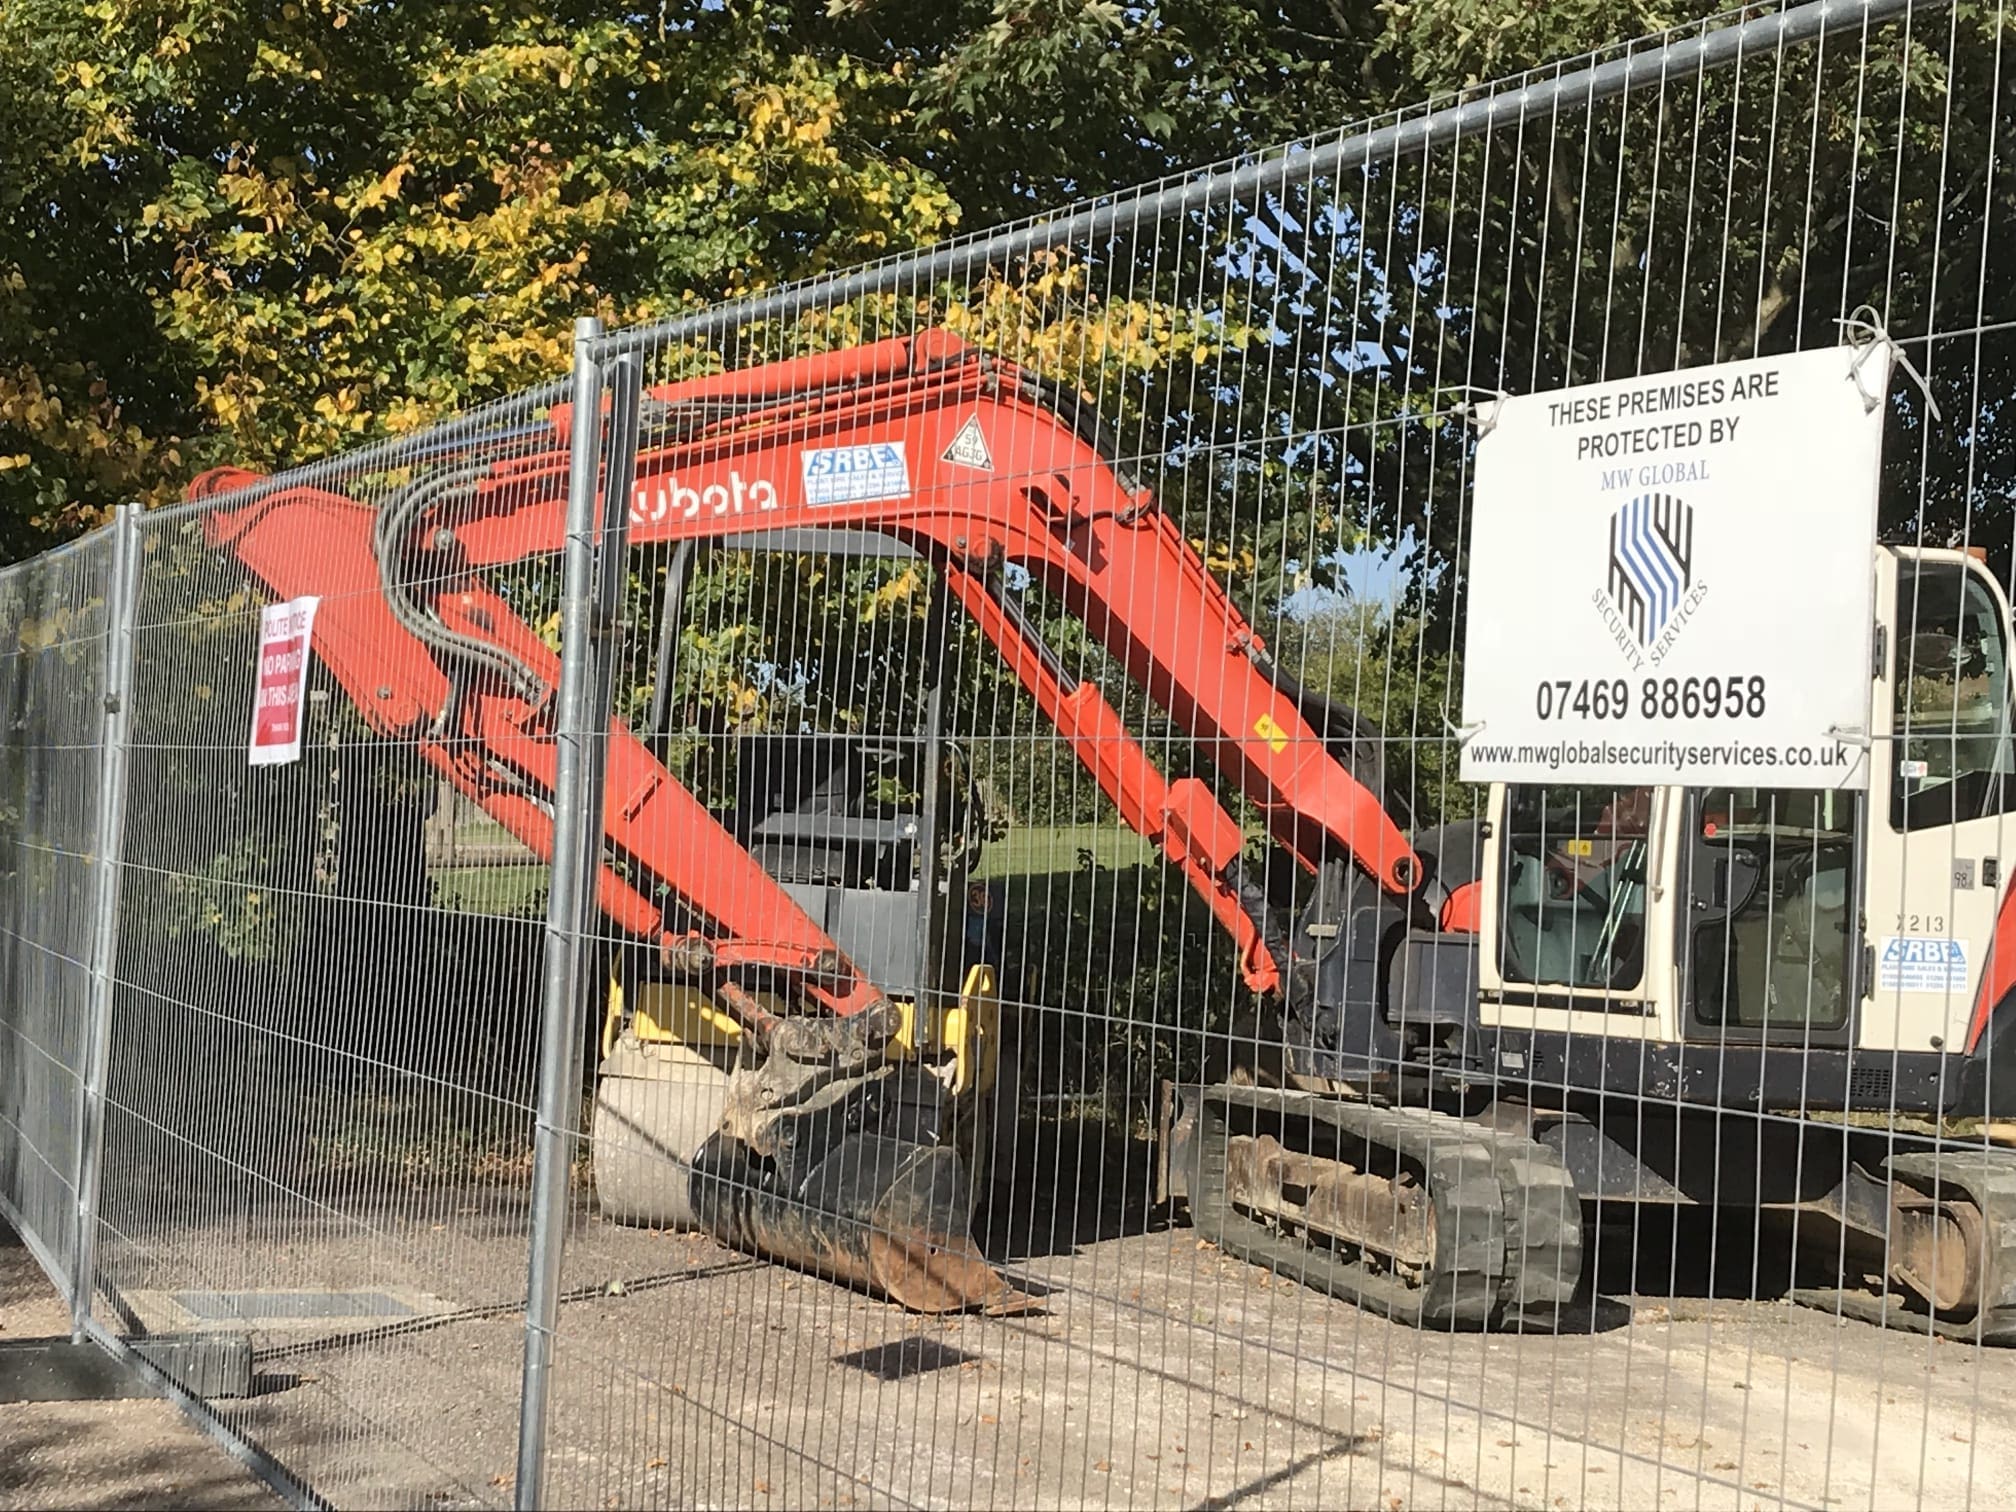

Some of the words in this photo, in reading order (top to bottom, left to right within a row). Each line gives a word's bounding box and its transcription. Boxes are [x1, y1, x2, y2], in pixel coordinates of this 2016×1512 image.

[1549, 396, 1611, 427] THESE
[1617, 378, 1725, 417] PREMISES
[1731, 371, 1779, 401] ARE
[1578, 421, 1702, 460] PROTECTED
[1710, 416, 1740, 444] BY
[1601, 468, 1633, 491] MW
[1639, 459, 1709, 486] GLOBAL
[1592, 588, 1644, 672] SECURITY
[1650, 579, 1708, 667] SERVICES
[275, 649, 301, 675] PARG
[1536, 679, 1629, 720] 07469
[1641, 675, 1766, 720] 886958
[1471, 740, 1848, 771] www.mwglobalsecurityservices.co.uk
